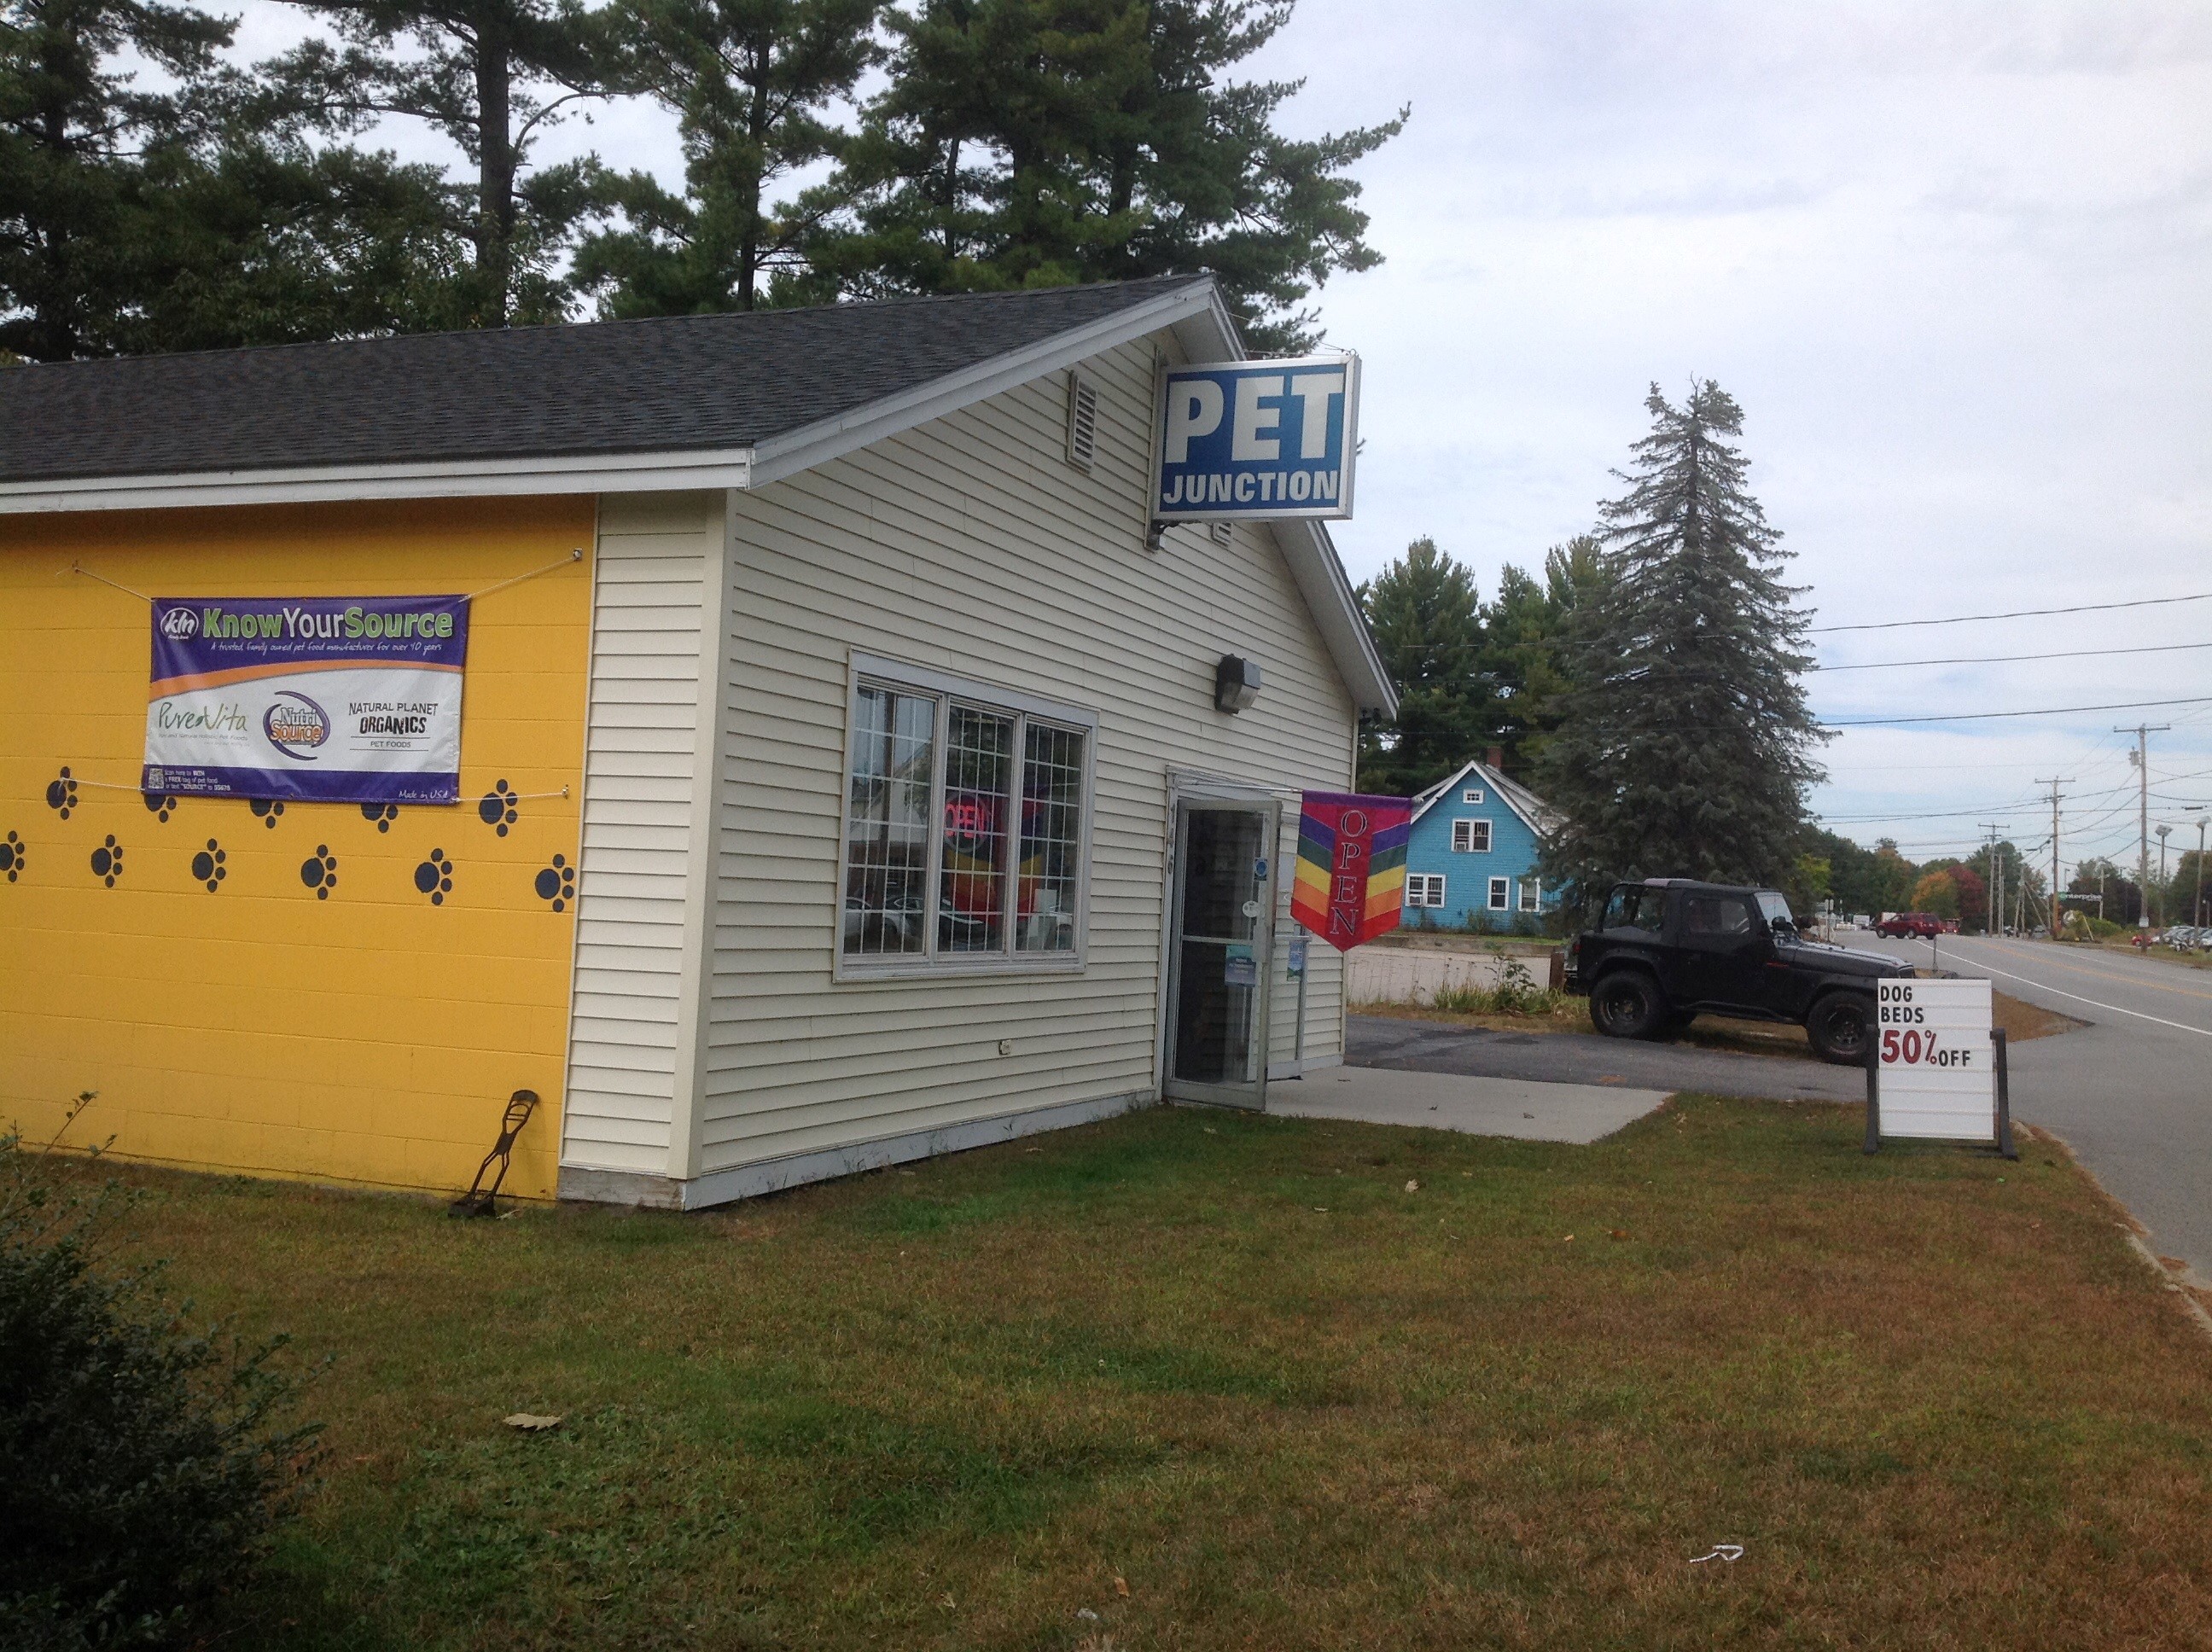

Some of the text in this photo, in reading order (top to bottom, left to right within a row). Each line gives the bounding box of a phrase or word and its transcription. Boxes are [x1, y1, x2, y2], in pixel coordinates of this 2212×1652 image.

[1165, 373, 1344, 463] PET
[1162, 470, 1338, 503] JUNCTION
[211, 642, 217, 650] A
[218, 641, 244, 651] trusted
[247, 641, 268, 655] family
[294, 642, 306, 655] pet
[307, 641, 325, 651] food
[327, 641, 375, 651] manufacturer
[377, 642, 389, 651] for
[422, 643, 442, 655] years
[280, 707, 318, 725] Nutri
[348, 702, 439, 717] NATURAL PLANET
[270, 719, 324, 742] Source
[359, 715, 428, 735] ORGANICS
[399, 789, 448, 800] Made in USA
[944, 803, 985, 838] OPEN
[1330, 809, 1367, 936] OPEN
[1880, 986, 1913, 1003] DOG
[1881, 1006, 1924, 1024] BEDS
[1881, 1029, 1970, 1067] 50% OFF
